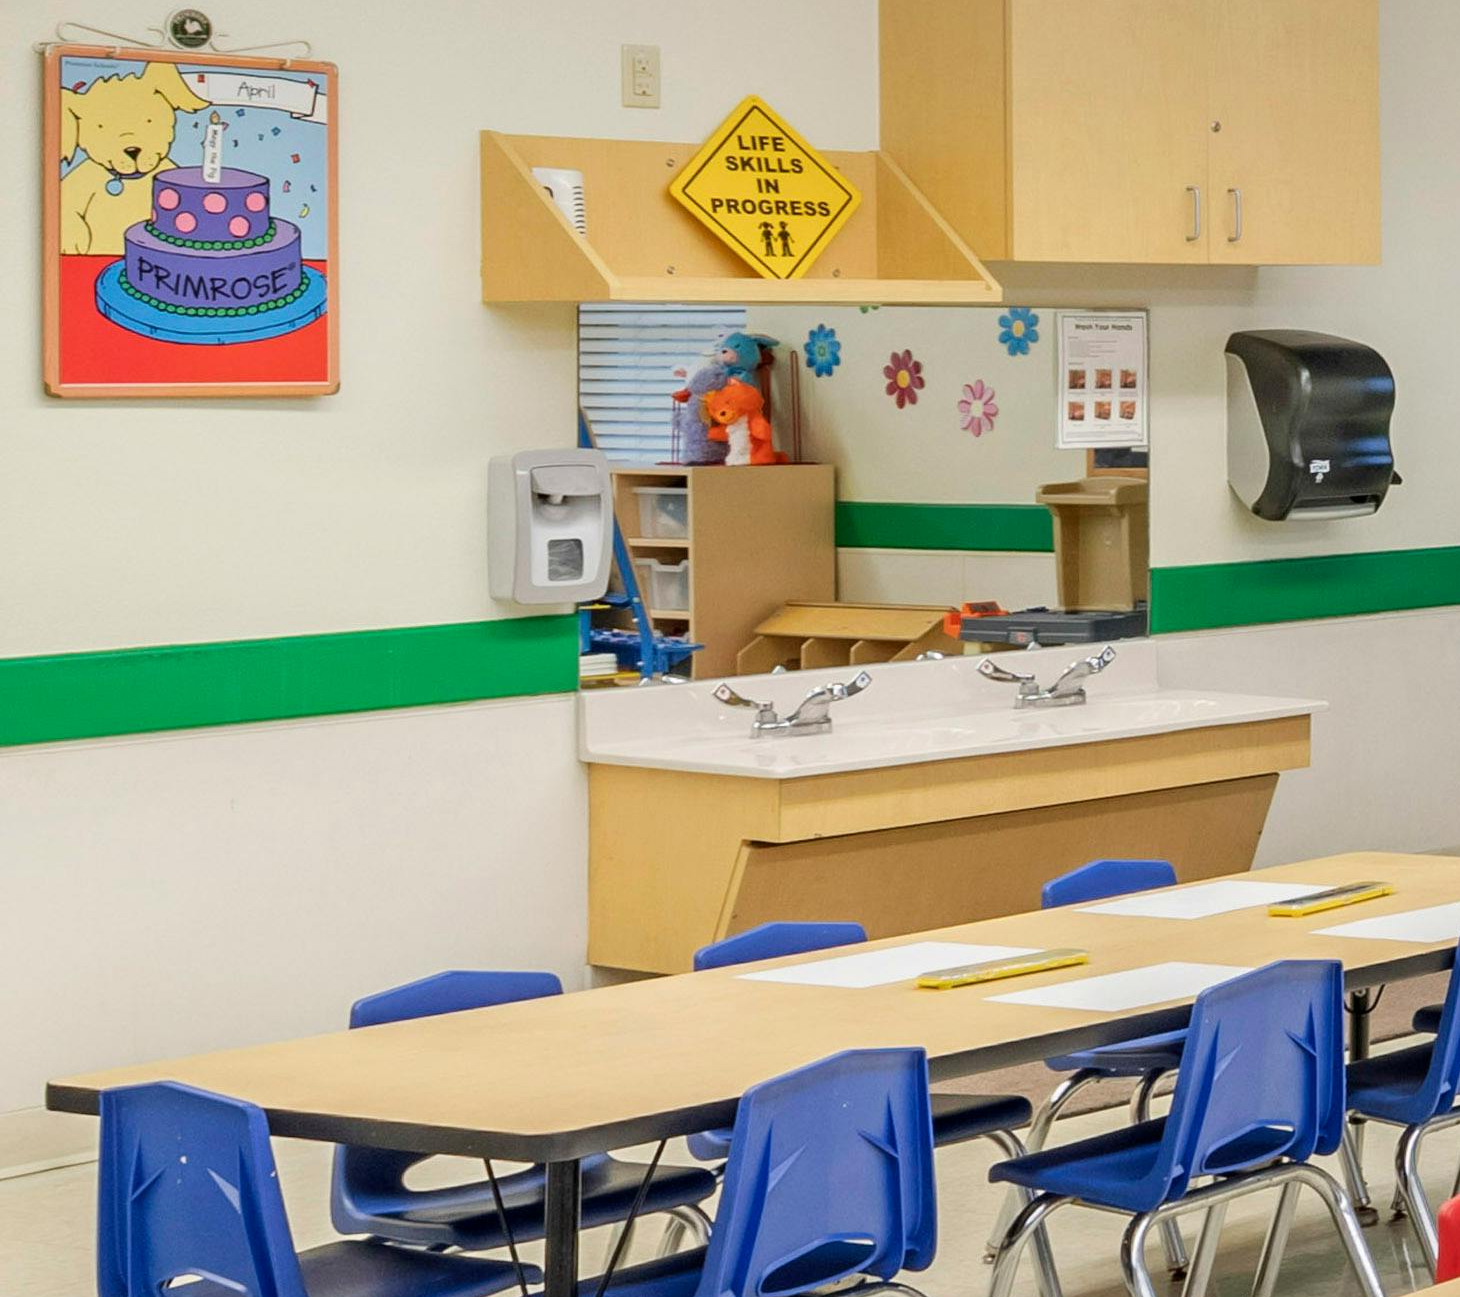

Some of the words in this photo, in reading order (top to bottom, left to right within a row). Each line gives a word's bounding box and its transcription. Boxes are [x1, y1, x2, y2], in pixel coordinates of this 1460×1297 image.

[237, 81, 276, 100] April
[738, 136, 785, 152] LIFE
[725, 156, 803, 174] SKILLS
[757, 179, 780, 194] IN
[711, 198, 831, 217] PROGRESS
